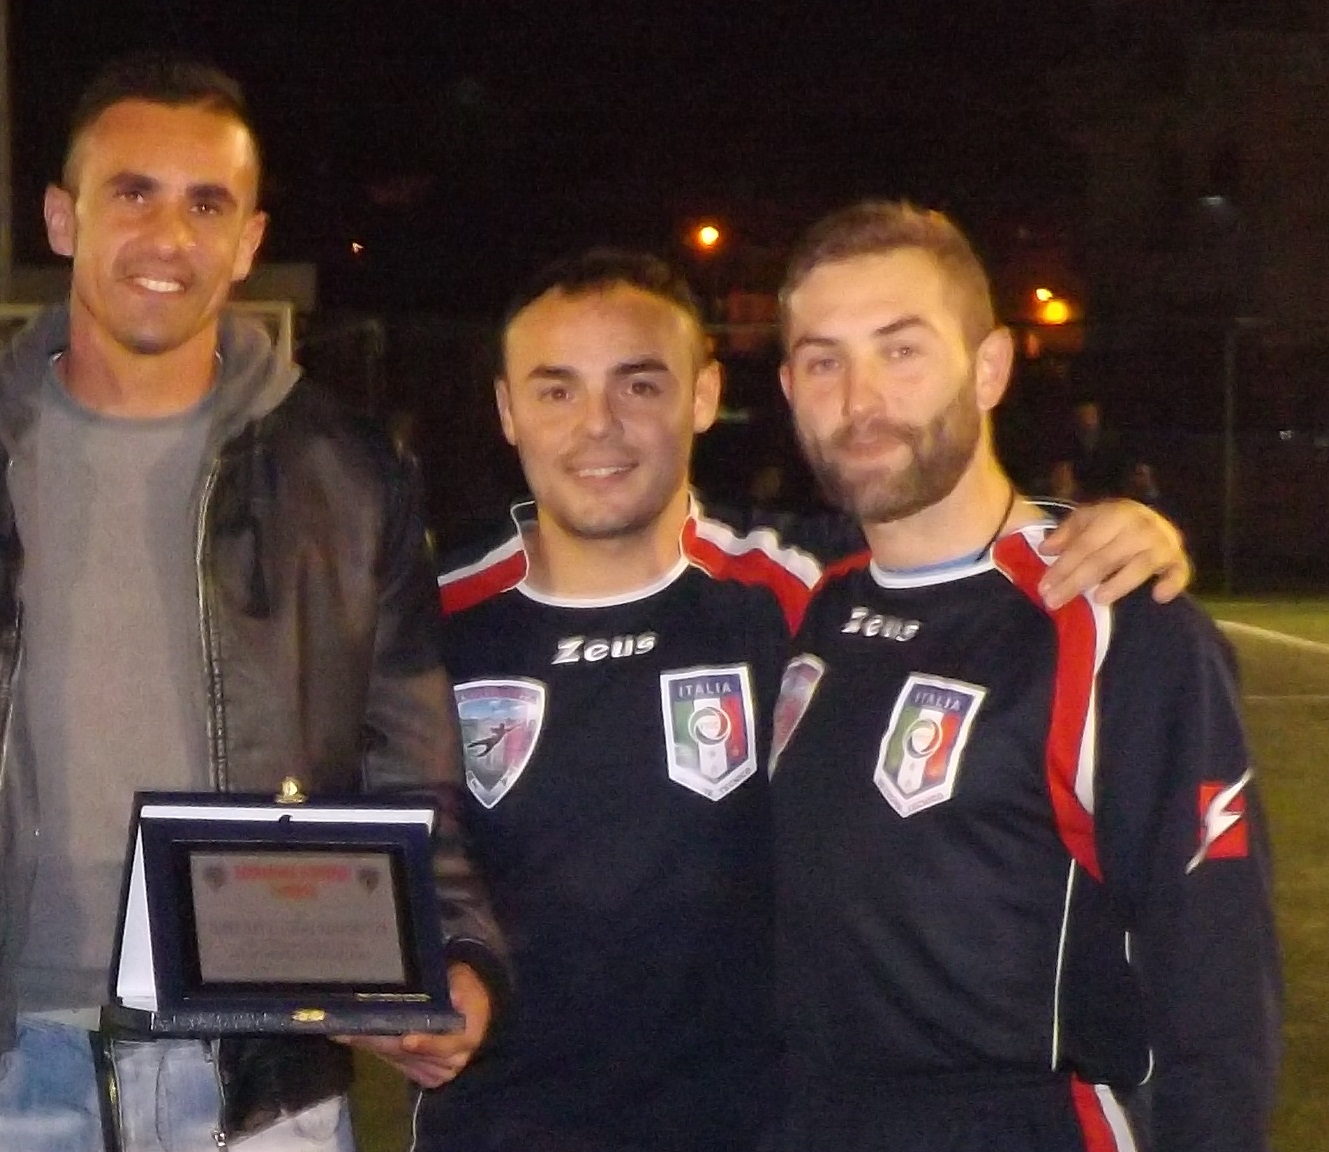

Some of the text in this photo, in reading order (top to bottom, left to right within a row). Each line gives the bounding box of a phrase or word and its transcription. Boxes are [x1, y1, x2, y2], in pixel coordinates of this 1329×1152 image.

[841, 606, 921, 642] Zeus
[551, 631, 658, 665] Zeus
[678, 682, 732, 698] ITALIA
[913, 691, 962, 711] ITALIA
